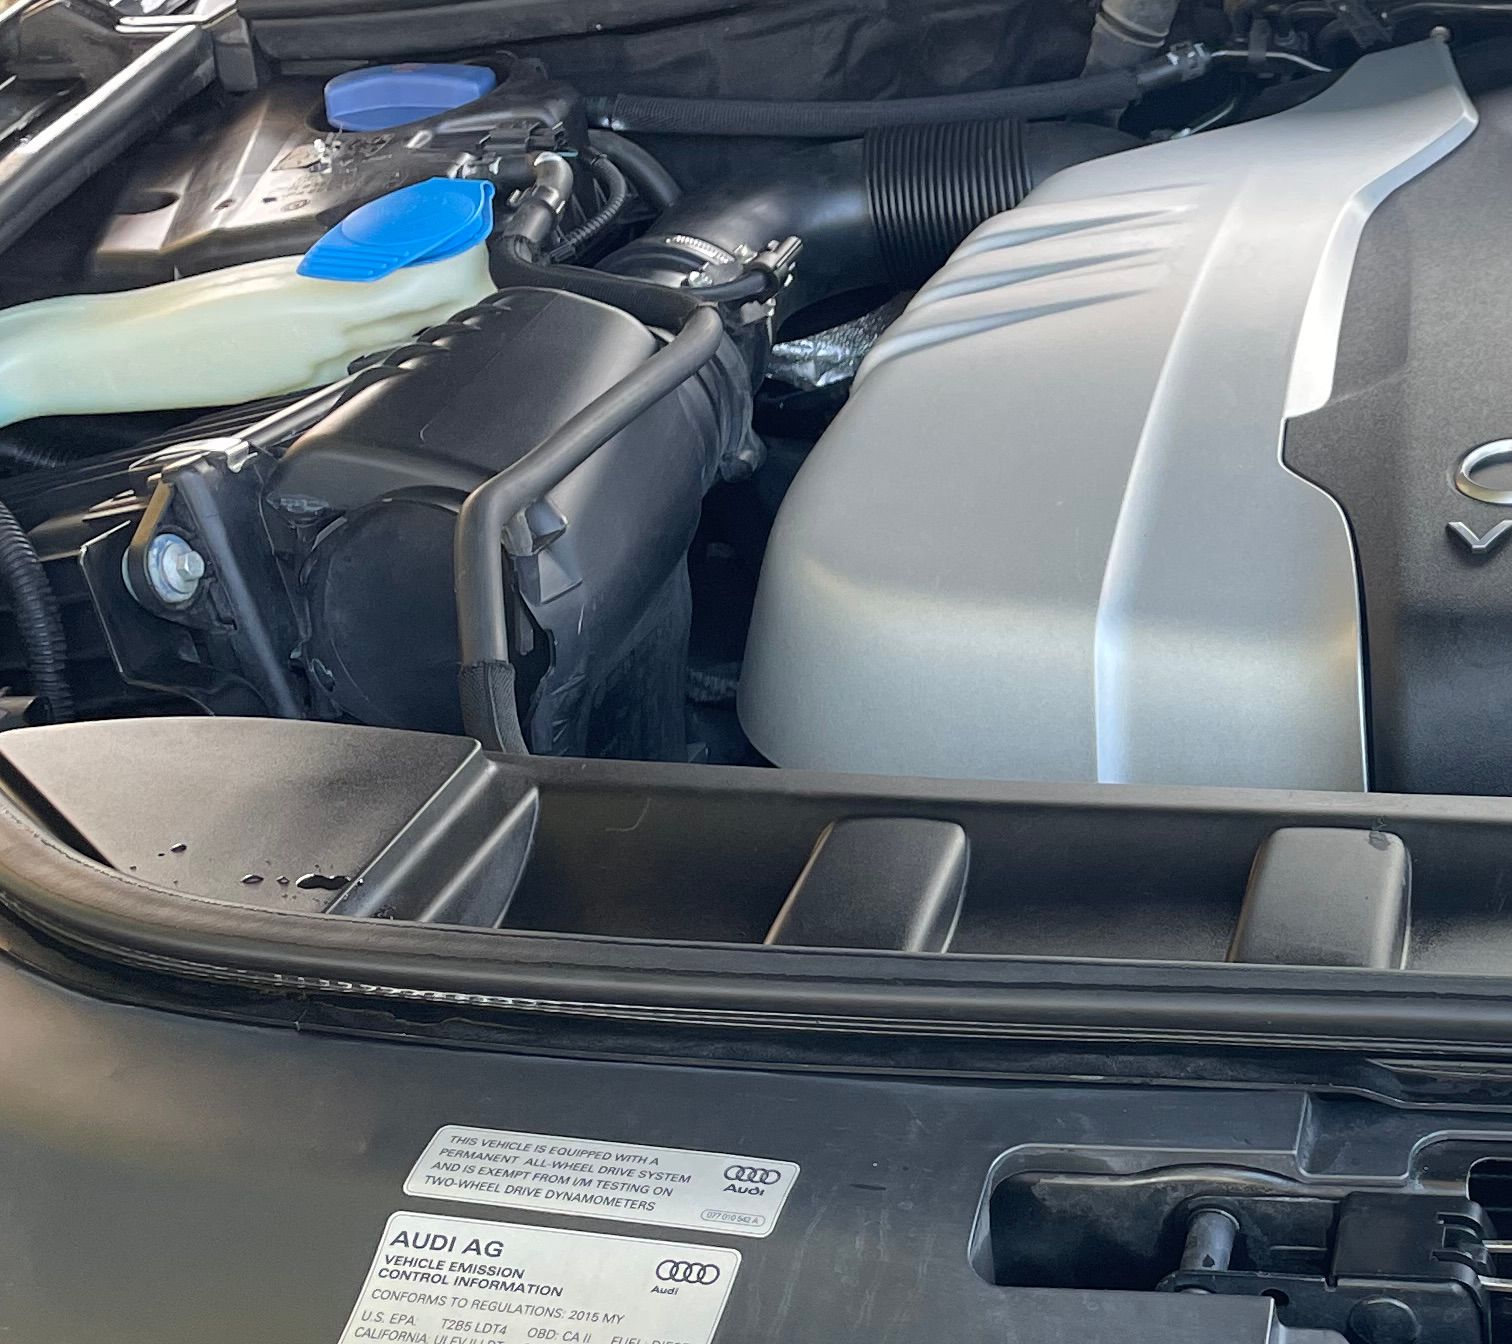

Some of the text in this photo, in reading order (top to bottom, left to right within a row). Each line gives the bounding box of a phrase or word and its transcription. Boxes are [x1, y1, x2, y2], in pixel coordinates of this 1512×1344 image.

[439, 1148, 692, 1184] PERMANENT ALL-WHEEL DRIVE SYSTEM
[450, 1135, 659, 1166] THIS VEHICLE IS EQUIPPED WITH A
[424, 1175, 656, 1212] TWO-WHEEL DRIVE DYNAMOMETERS
[431, 1161, 674, 1197] AND IS EXEMPT FROM I/M TESTING ON
[723, 1183, 765, 1196] Audi
[389, 1230, 505, 1258] AUDI AG
[378, 1267, 564, 1297] CONTROL INFORMATION
[385, 1254, 526, 1279] VEHICLE EMISSION
[650, 1285, 680, 1296] Audi
[371, 1288, 626, 1325] CONFORMS TO REGULATIONS: 2015 MY
[361, 1310, 385, 1324] U.S.
[441, 1318, 473, 1332] T2B5
[474, 1322, 507, 1336] LDT4
[527, 1327, 558, 1340] OBD:
[562, 1331, 580, 1343] CA
